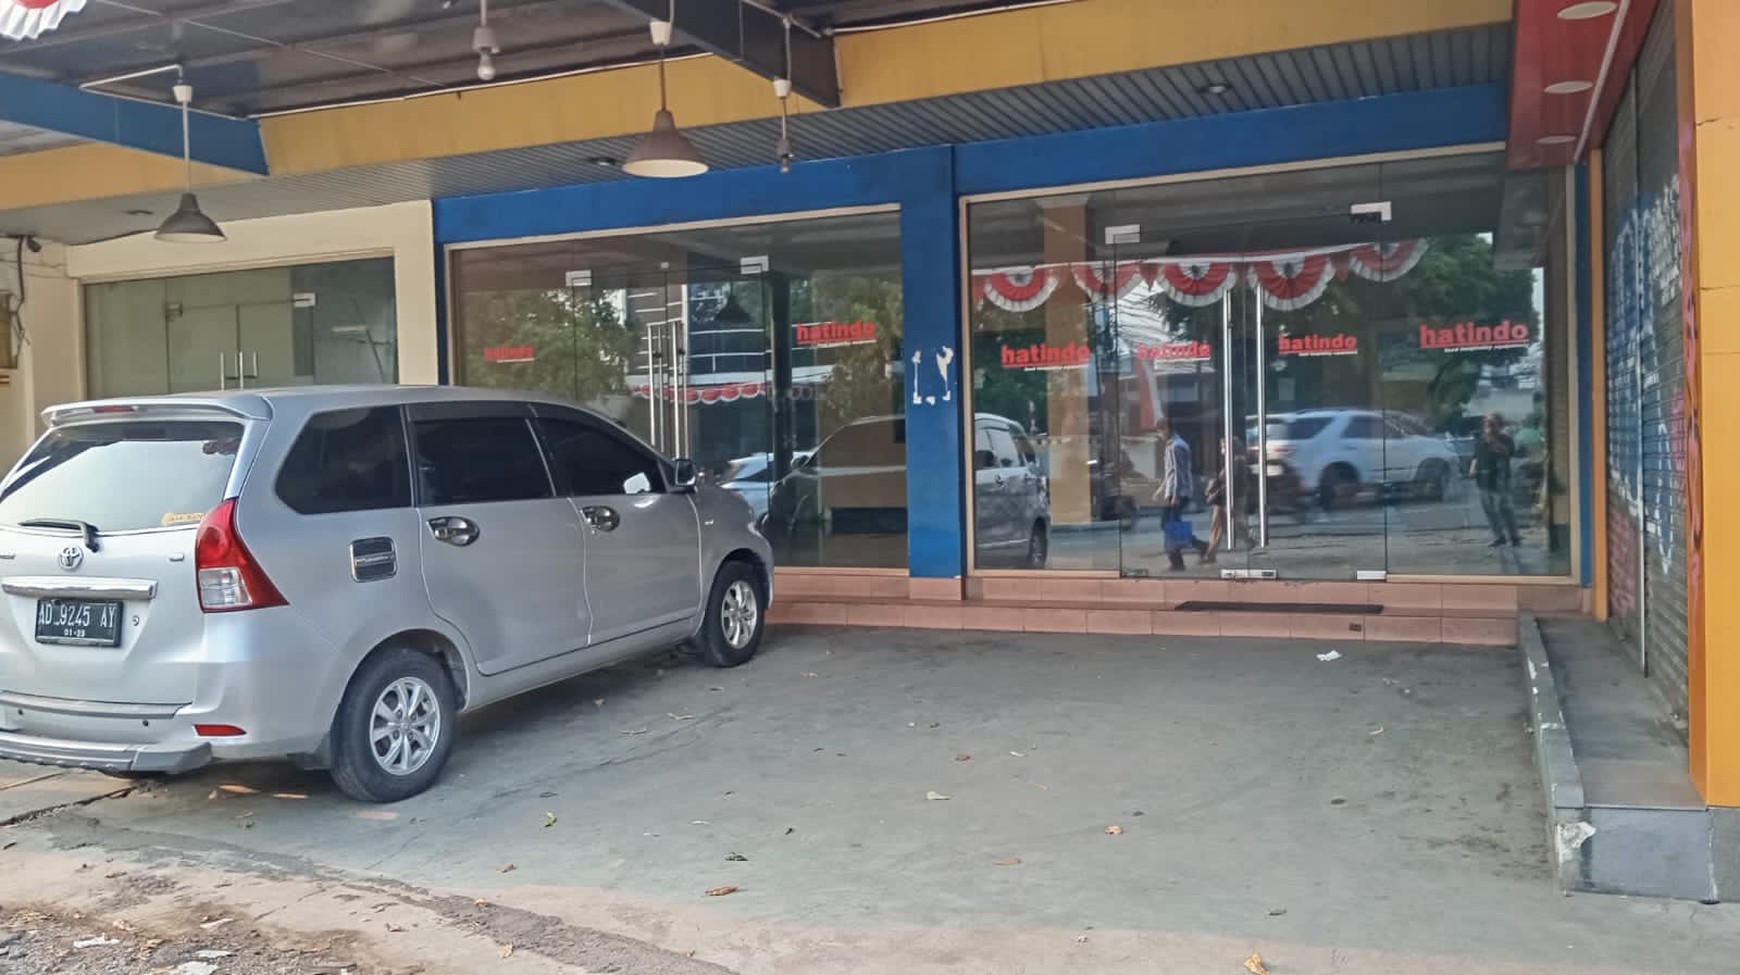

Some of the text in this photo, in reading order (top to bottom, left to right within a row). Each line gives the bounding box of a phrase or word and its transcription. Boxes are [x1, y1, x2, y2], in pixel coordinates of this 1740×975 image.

[797, 319, 875, 341] hatindo
[1279, 332, 1357, 351] hatindo
[1420, 320, 1528, 346] hatindo
[1002, 341, 1090, 365] hatindo
[38, 603, 116, 628] AD 9245 AY
